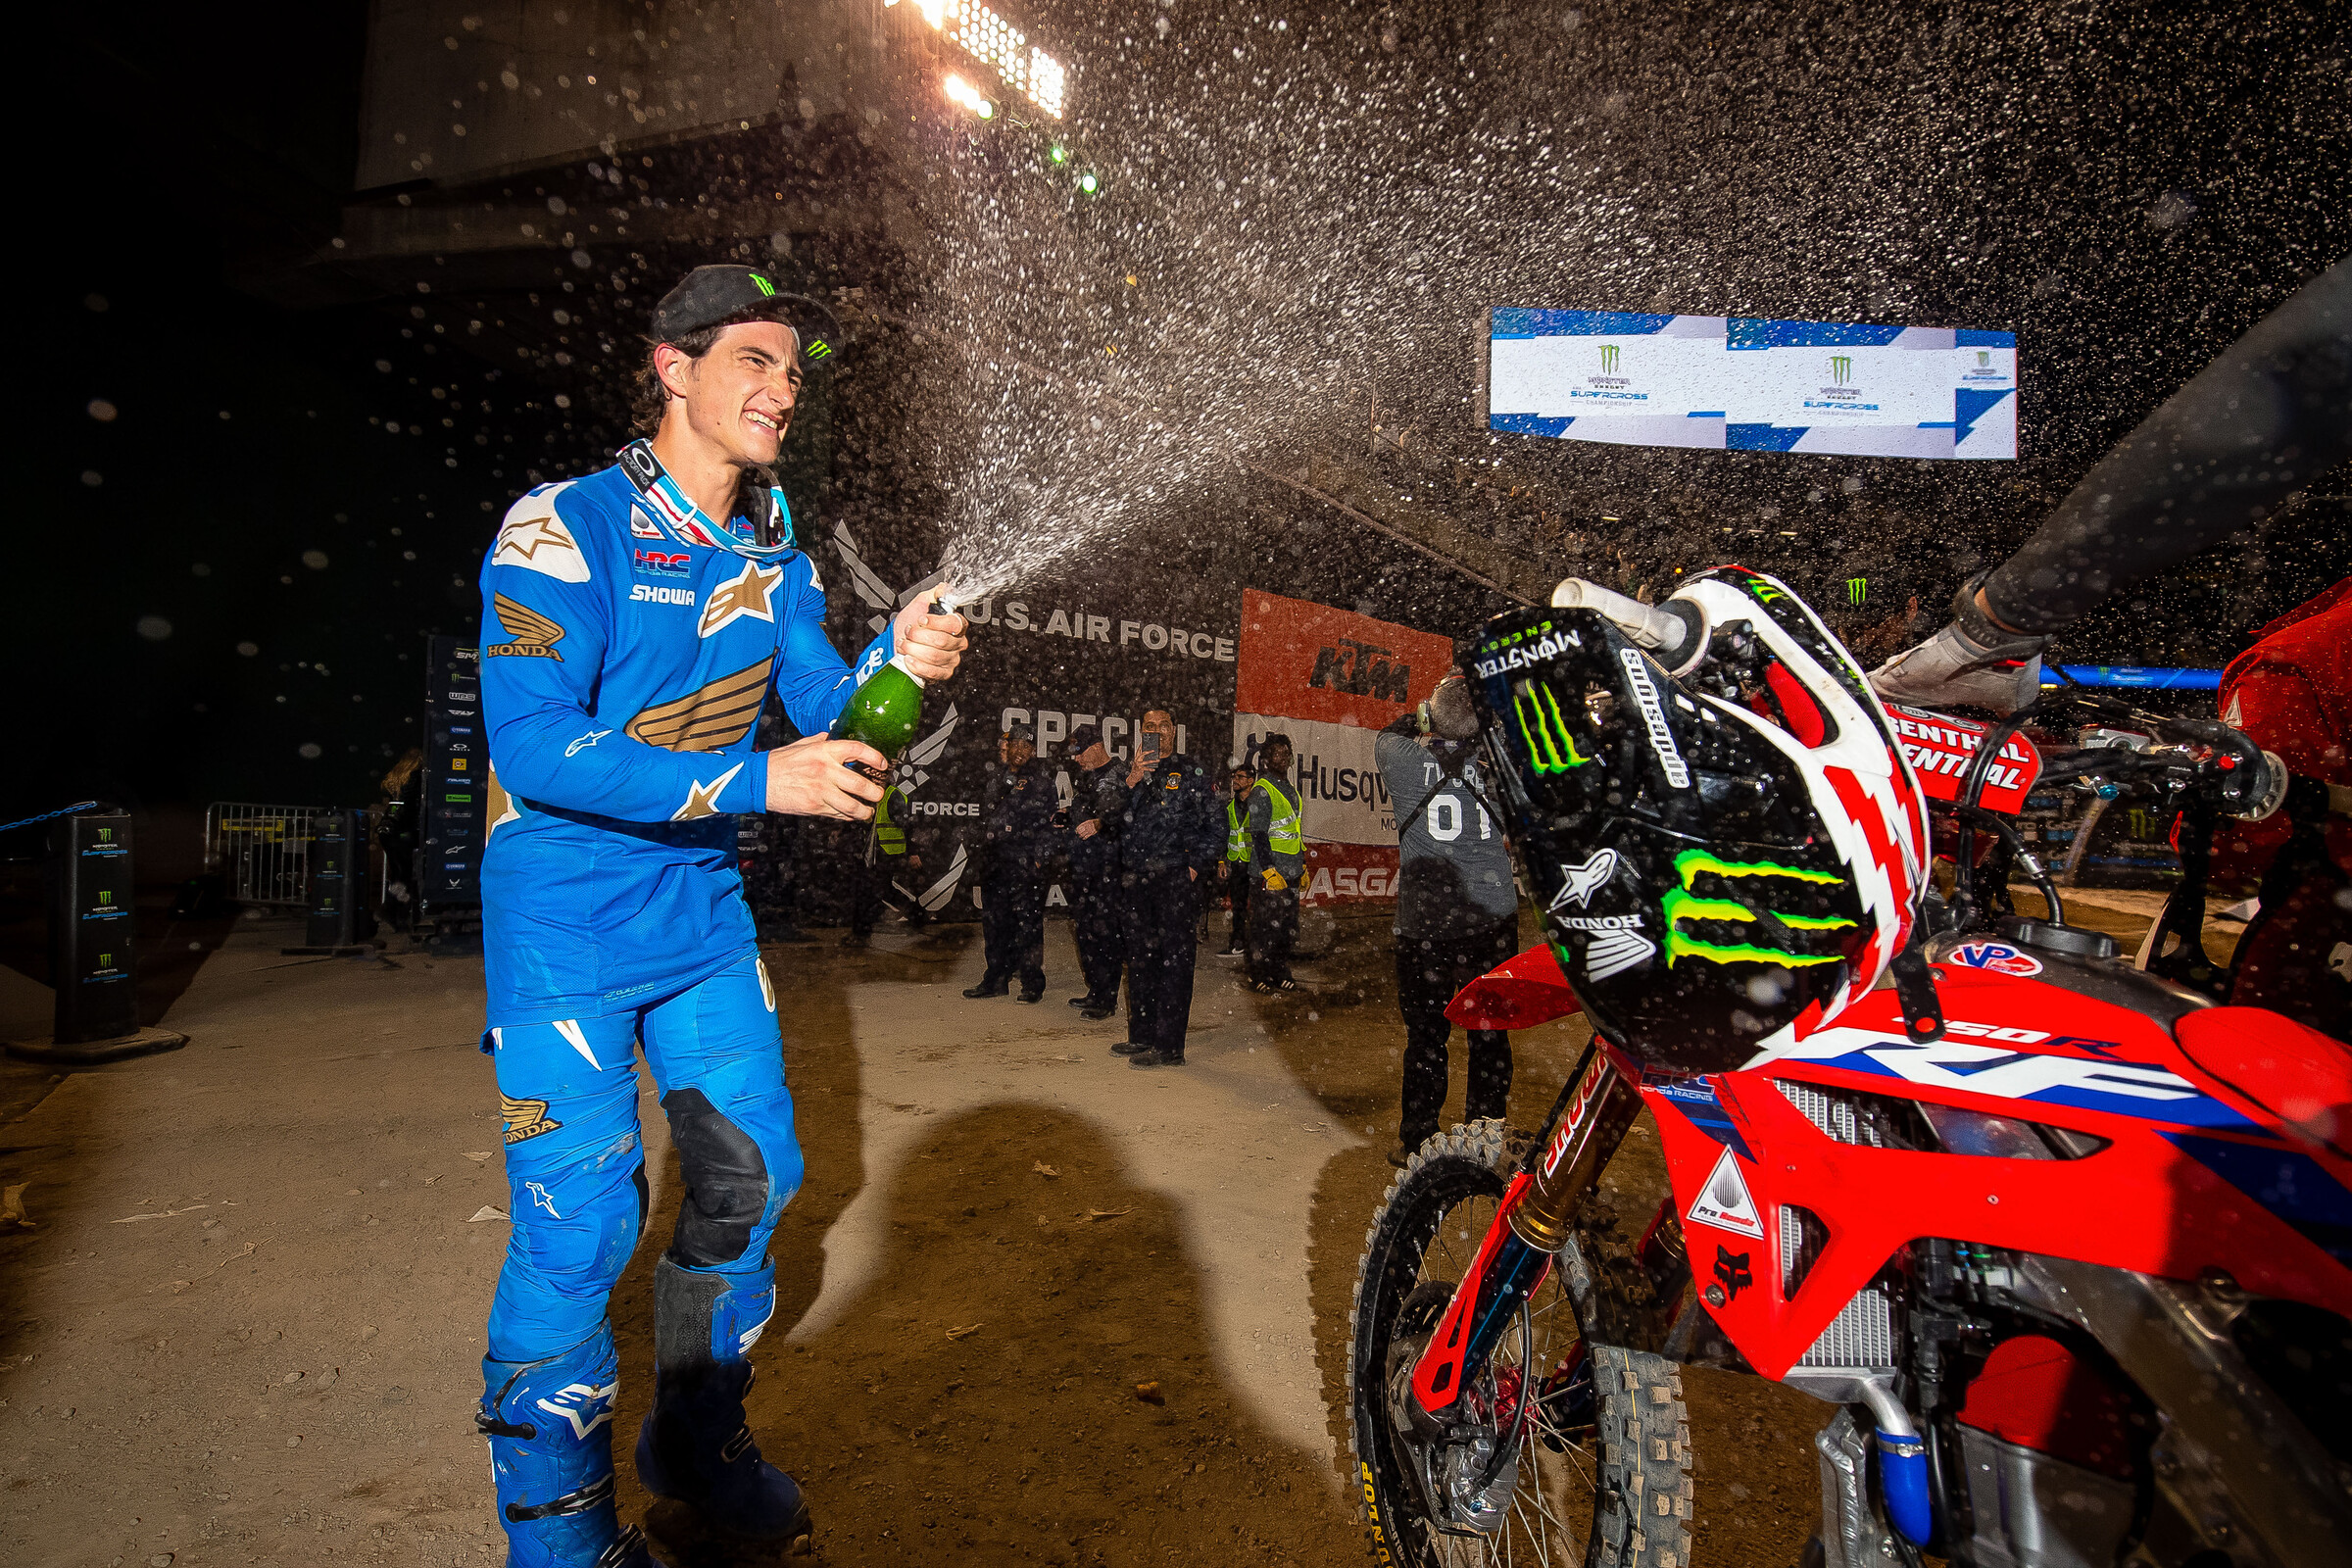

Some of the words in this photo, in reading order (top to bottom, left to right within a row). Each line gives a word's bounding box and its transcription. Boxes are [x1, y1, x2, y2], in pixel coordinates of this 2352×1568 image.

[635, 548, 691, 573] HRC
[629, 584, 696, 607] SHOWA
[1045, 609, 1111, 643] AIR
[1120, 619, 1236, 662] FORCE
[487, 645, 565, 662] HONDA
[1474, 628, 1582, 679] MONSTER
[1308, 637, 1411, 704] KTM
[911, 802, 980, 816] FORCE
[1555, 914, 1645, 930] HONDA
[1963, 945, 2015, 969] VP
[1674, 1090, 1714, 1102] RACING
[503, 1119, 561, 1144] ONDA
[1361, 1461, 1394, 1568] UNLOP
